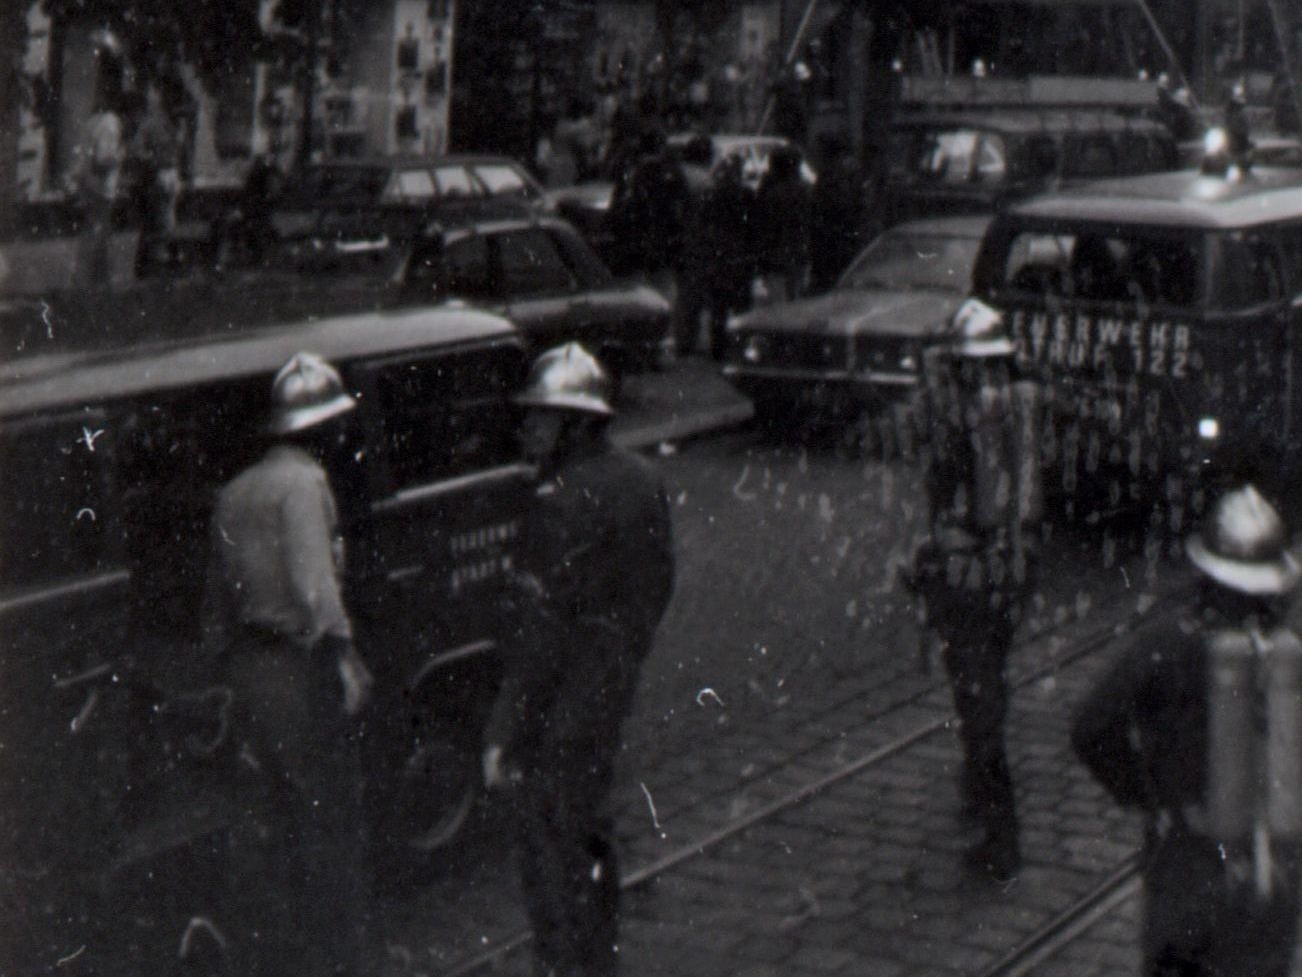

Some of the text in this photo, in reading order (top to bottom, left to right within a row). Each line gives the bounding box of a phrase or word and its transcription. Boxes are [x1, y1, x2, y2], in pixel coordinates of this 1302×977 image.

[1012, 309, 1190, 351] EUERWEHR
[1013, 337, 1188, 378] OTRUF 122
